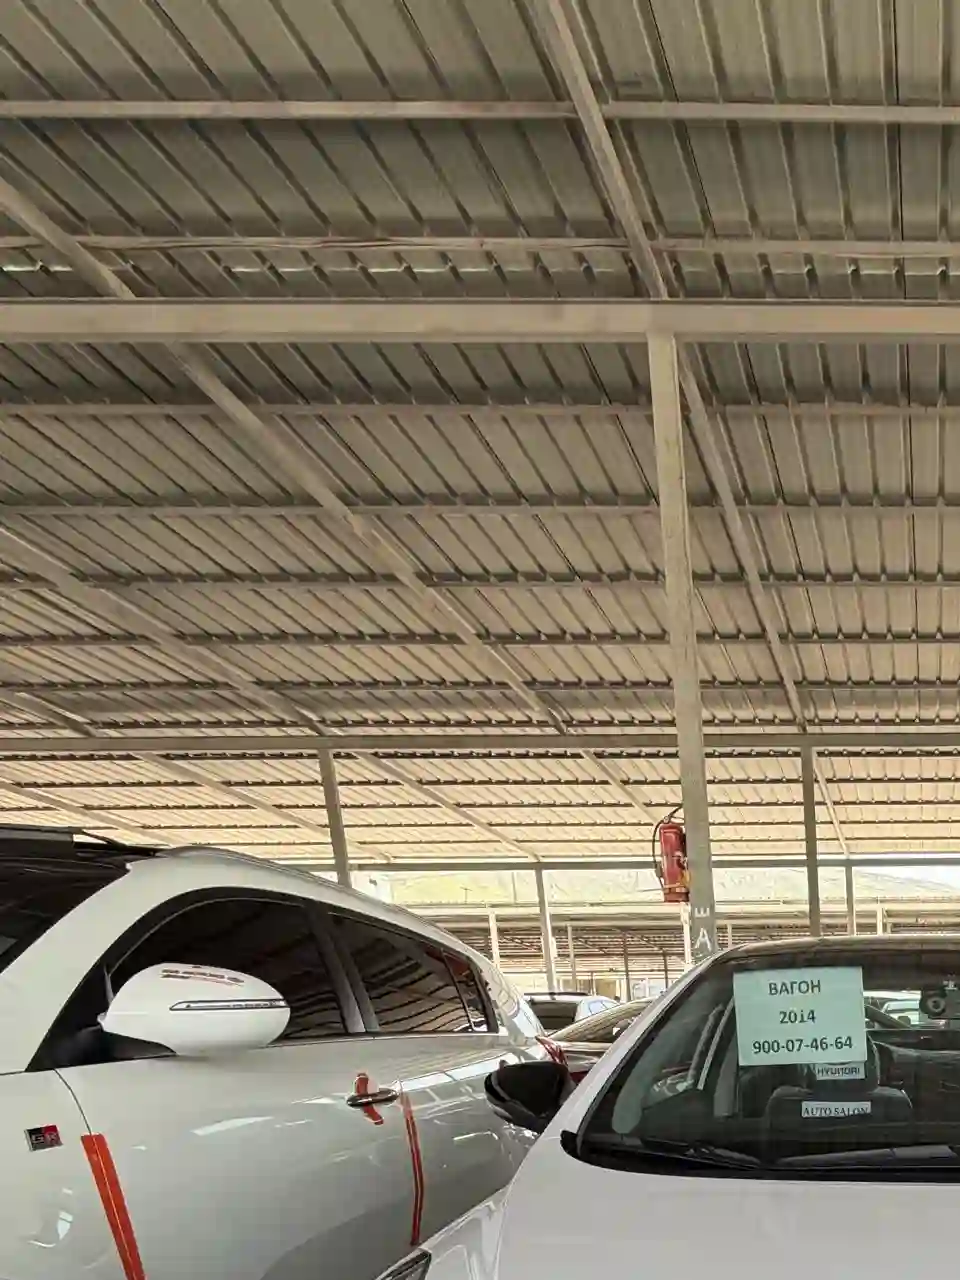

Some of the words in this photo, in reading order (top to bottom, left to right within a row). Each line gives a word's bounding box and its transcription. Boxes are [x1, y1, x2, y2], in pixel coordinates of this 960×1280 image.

[768, 980, 821, 996] ВАГОН
[779, 1009, 817, 1025] 2014
[752, 1035, 854, 1055] 900-07-46-64
[803, 1106, 832, 1117] AUTO
[834, 1106, 868, 1118] SALON
